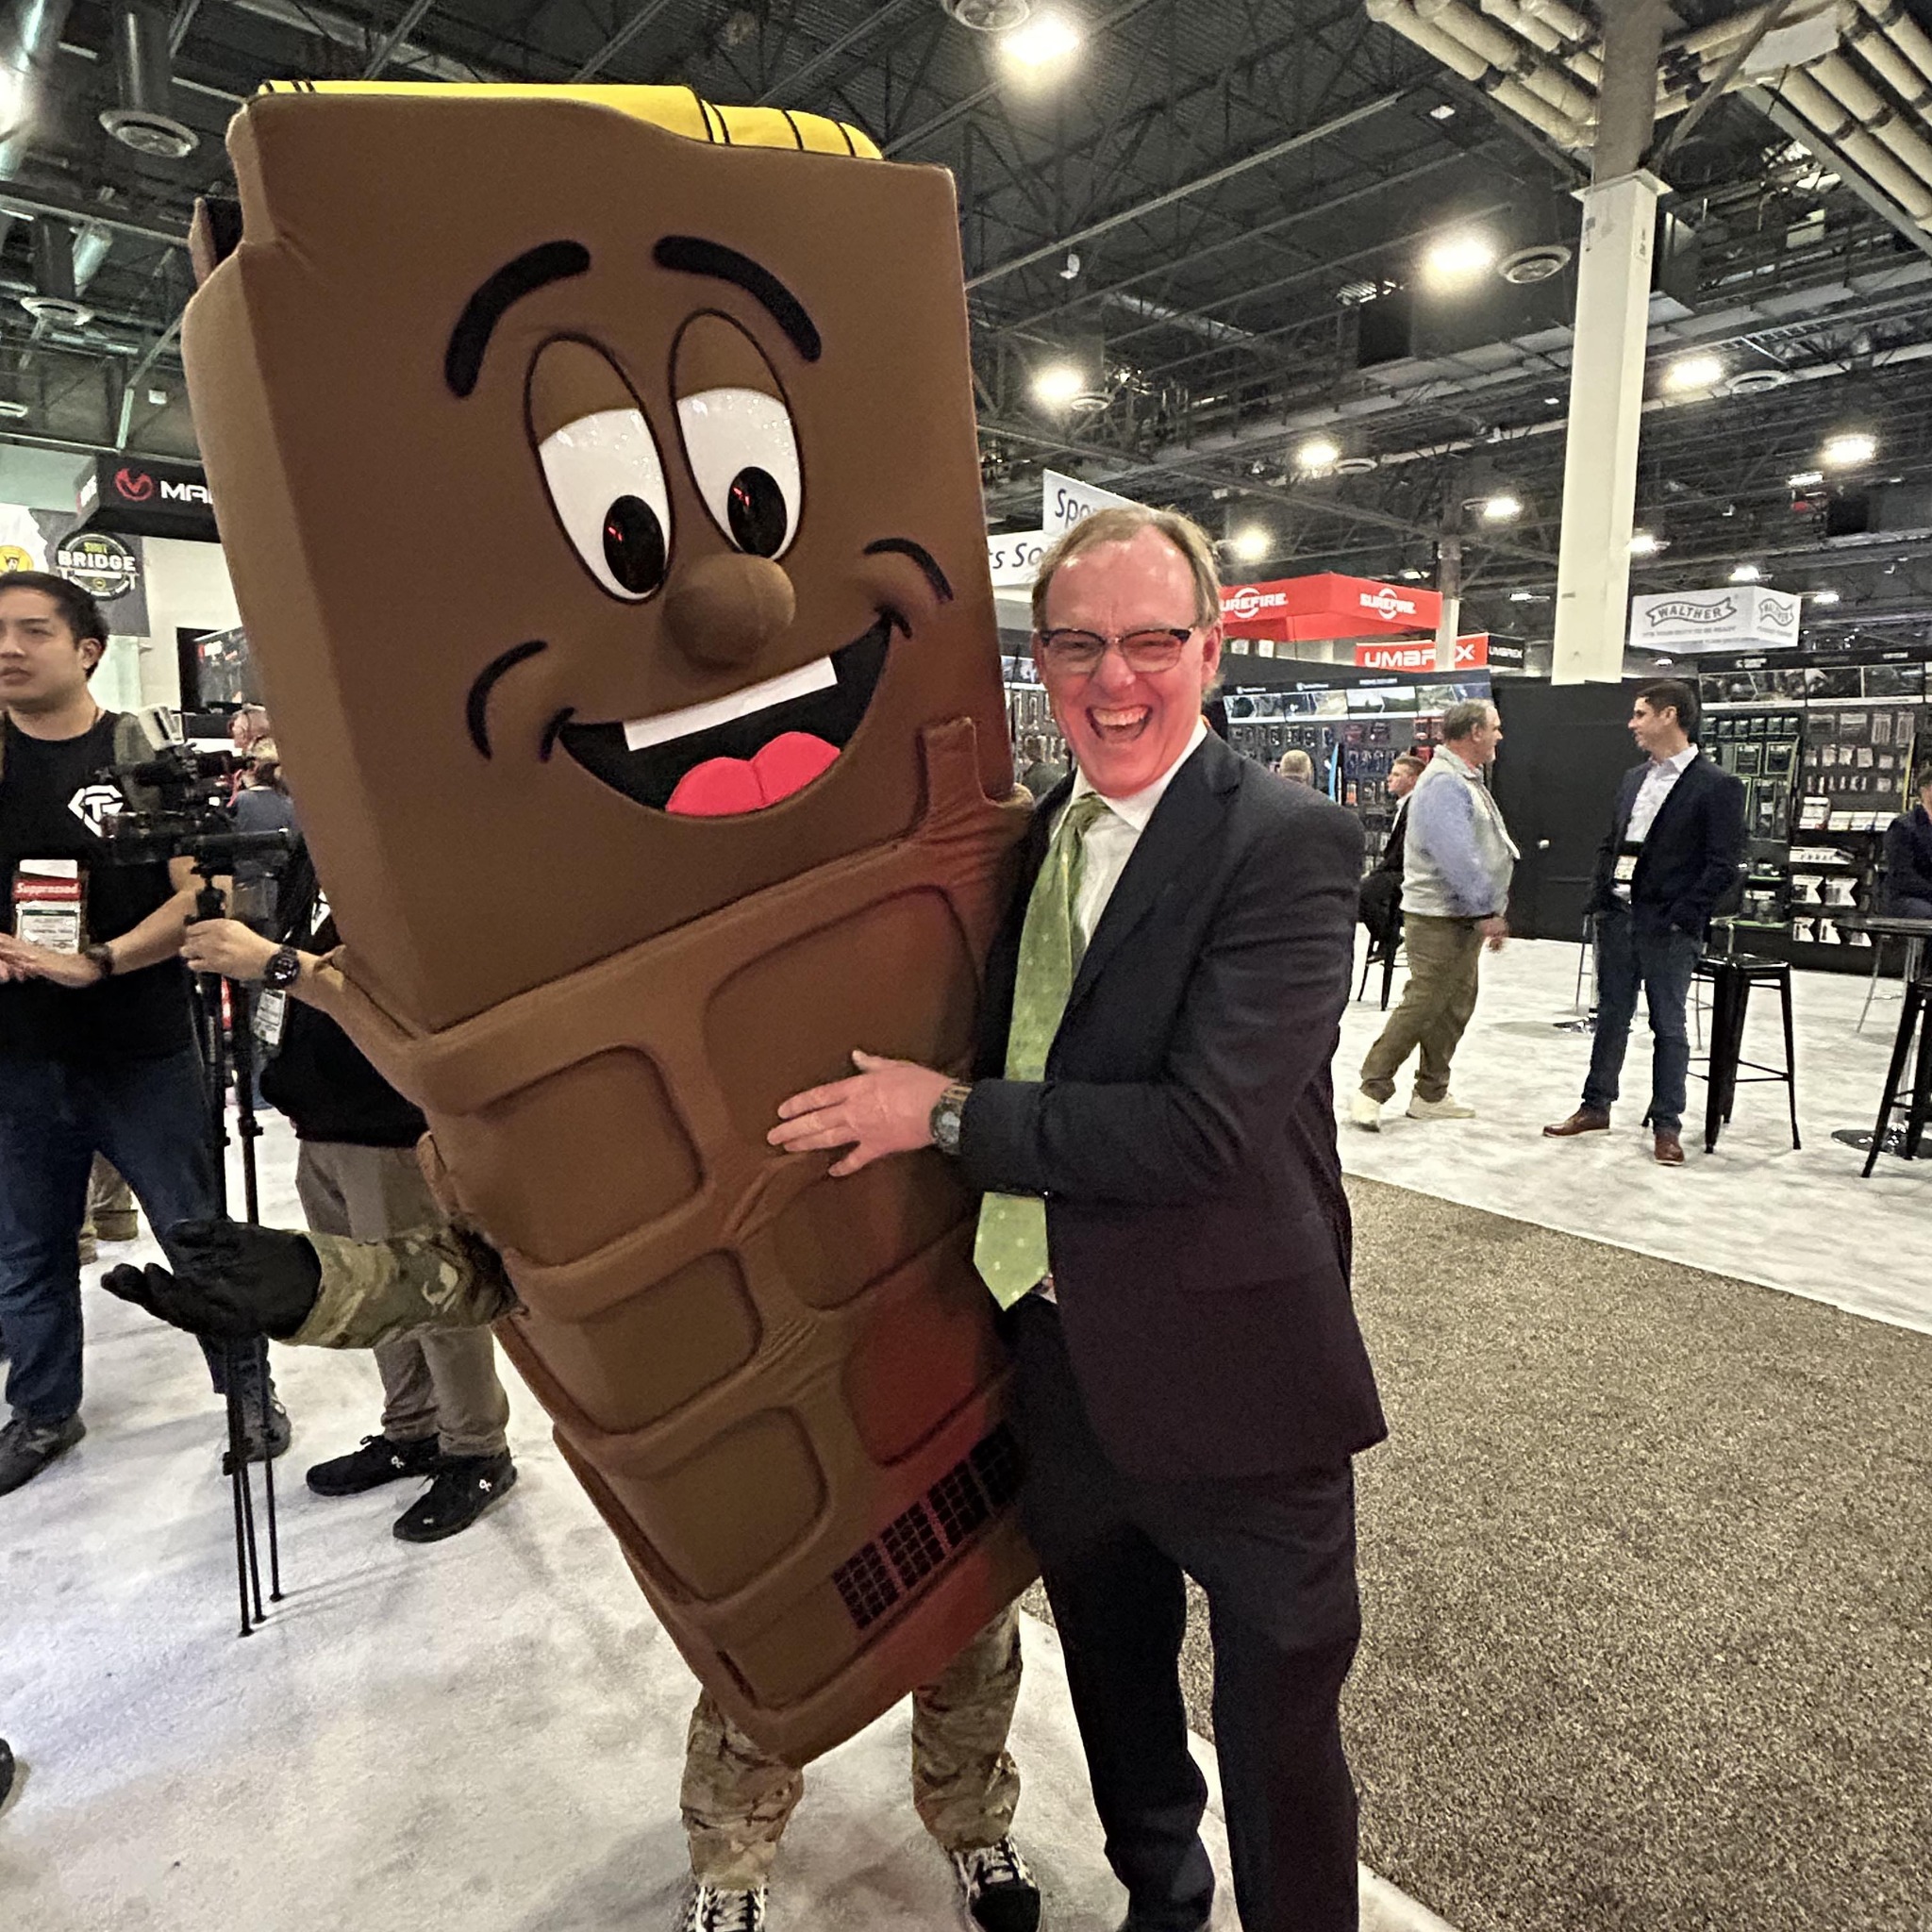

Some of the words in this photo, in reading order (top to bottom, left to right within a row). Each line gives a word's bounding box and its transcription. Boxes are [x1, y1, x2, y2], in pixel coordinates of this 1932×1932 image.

[160, 480, 213, 504] MA
[1055, 488, 1097, 528] Spo
[58, 550, 136, 572] BRIDGE
[1657, 607, 1723, 620] WALTHER
[1364, 643, 1475, 668] UMARX
[1488, 646, 1524, 659] UMAREX
